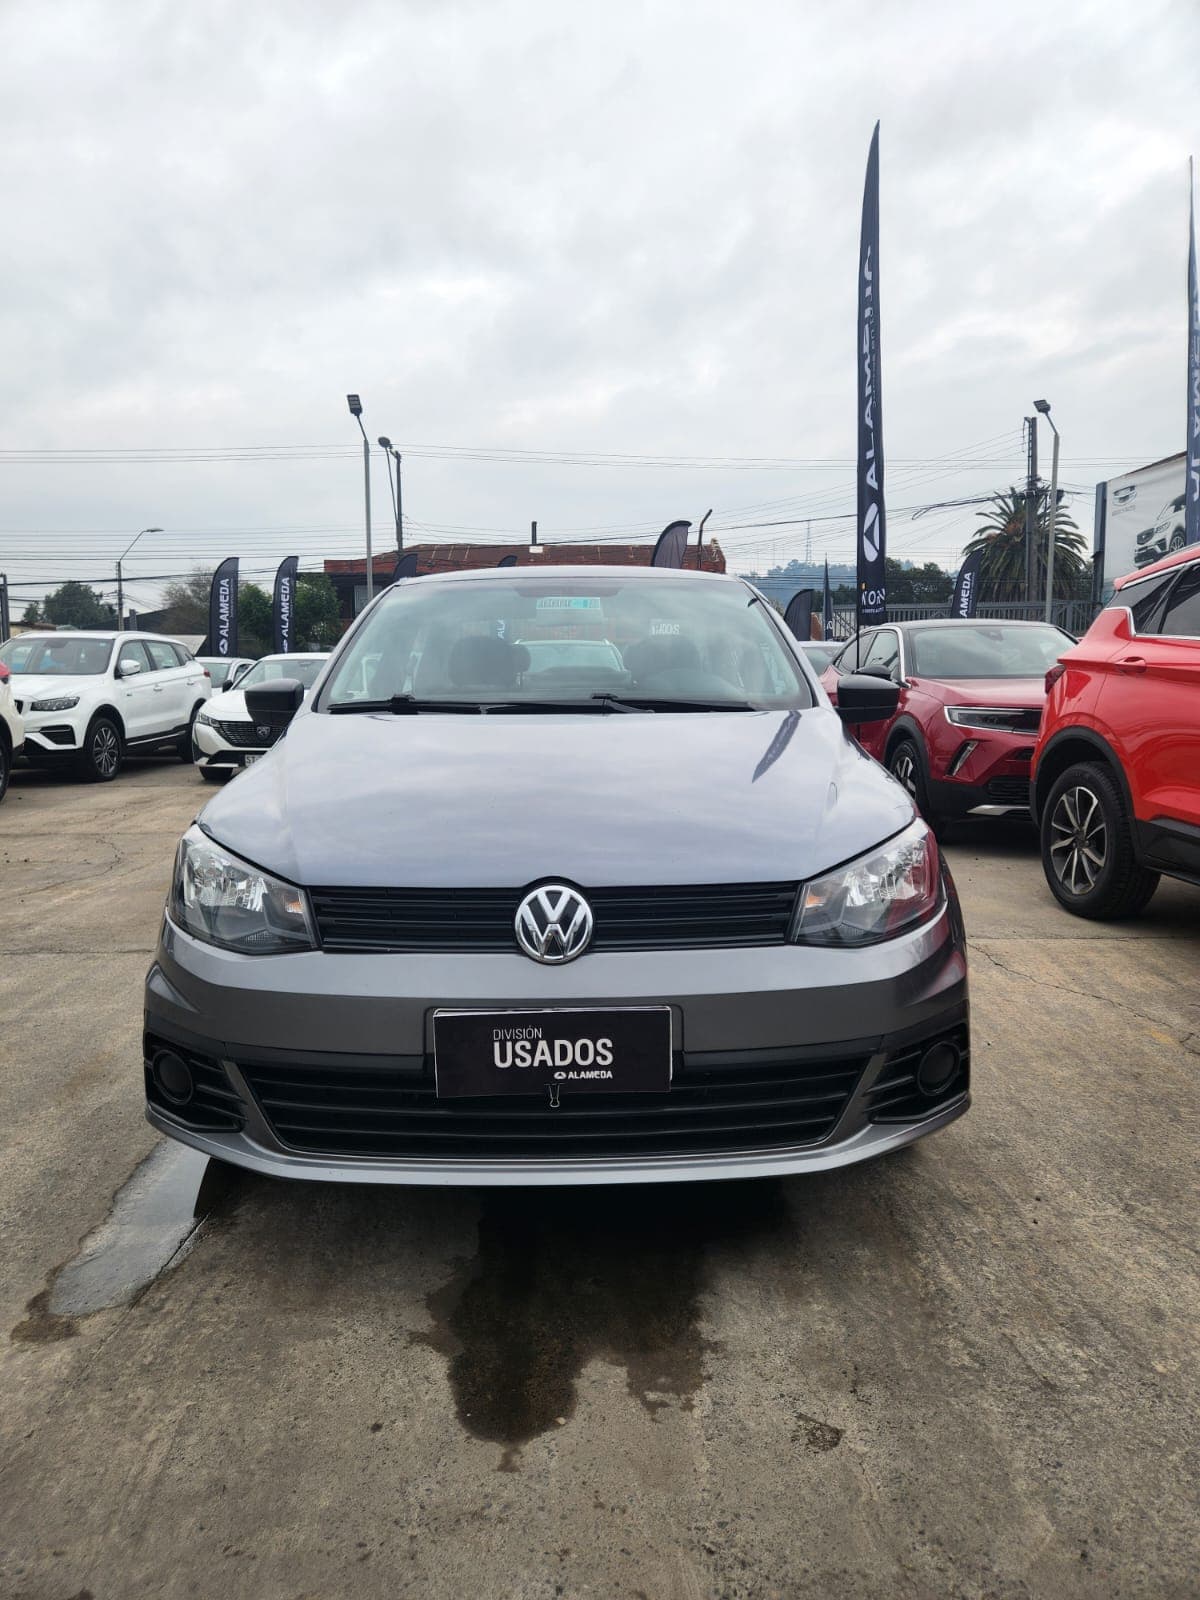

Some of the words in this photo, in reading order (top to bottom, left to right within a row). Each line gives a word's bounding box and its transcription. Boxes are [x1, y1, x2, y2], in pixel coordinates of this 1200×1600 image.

[219, 578, 230, 637] ALAMEDA
[281, 577, 290, 637] ALAMEDA
[493, 1026, 543, 1041] DIVISIÓN
[493, 1038, 614, 1068] USADOS
[567, 1070, 613, 1080] ALAMEDA
